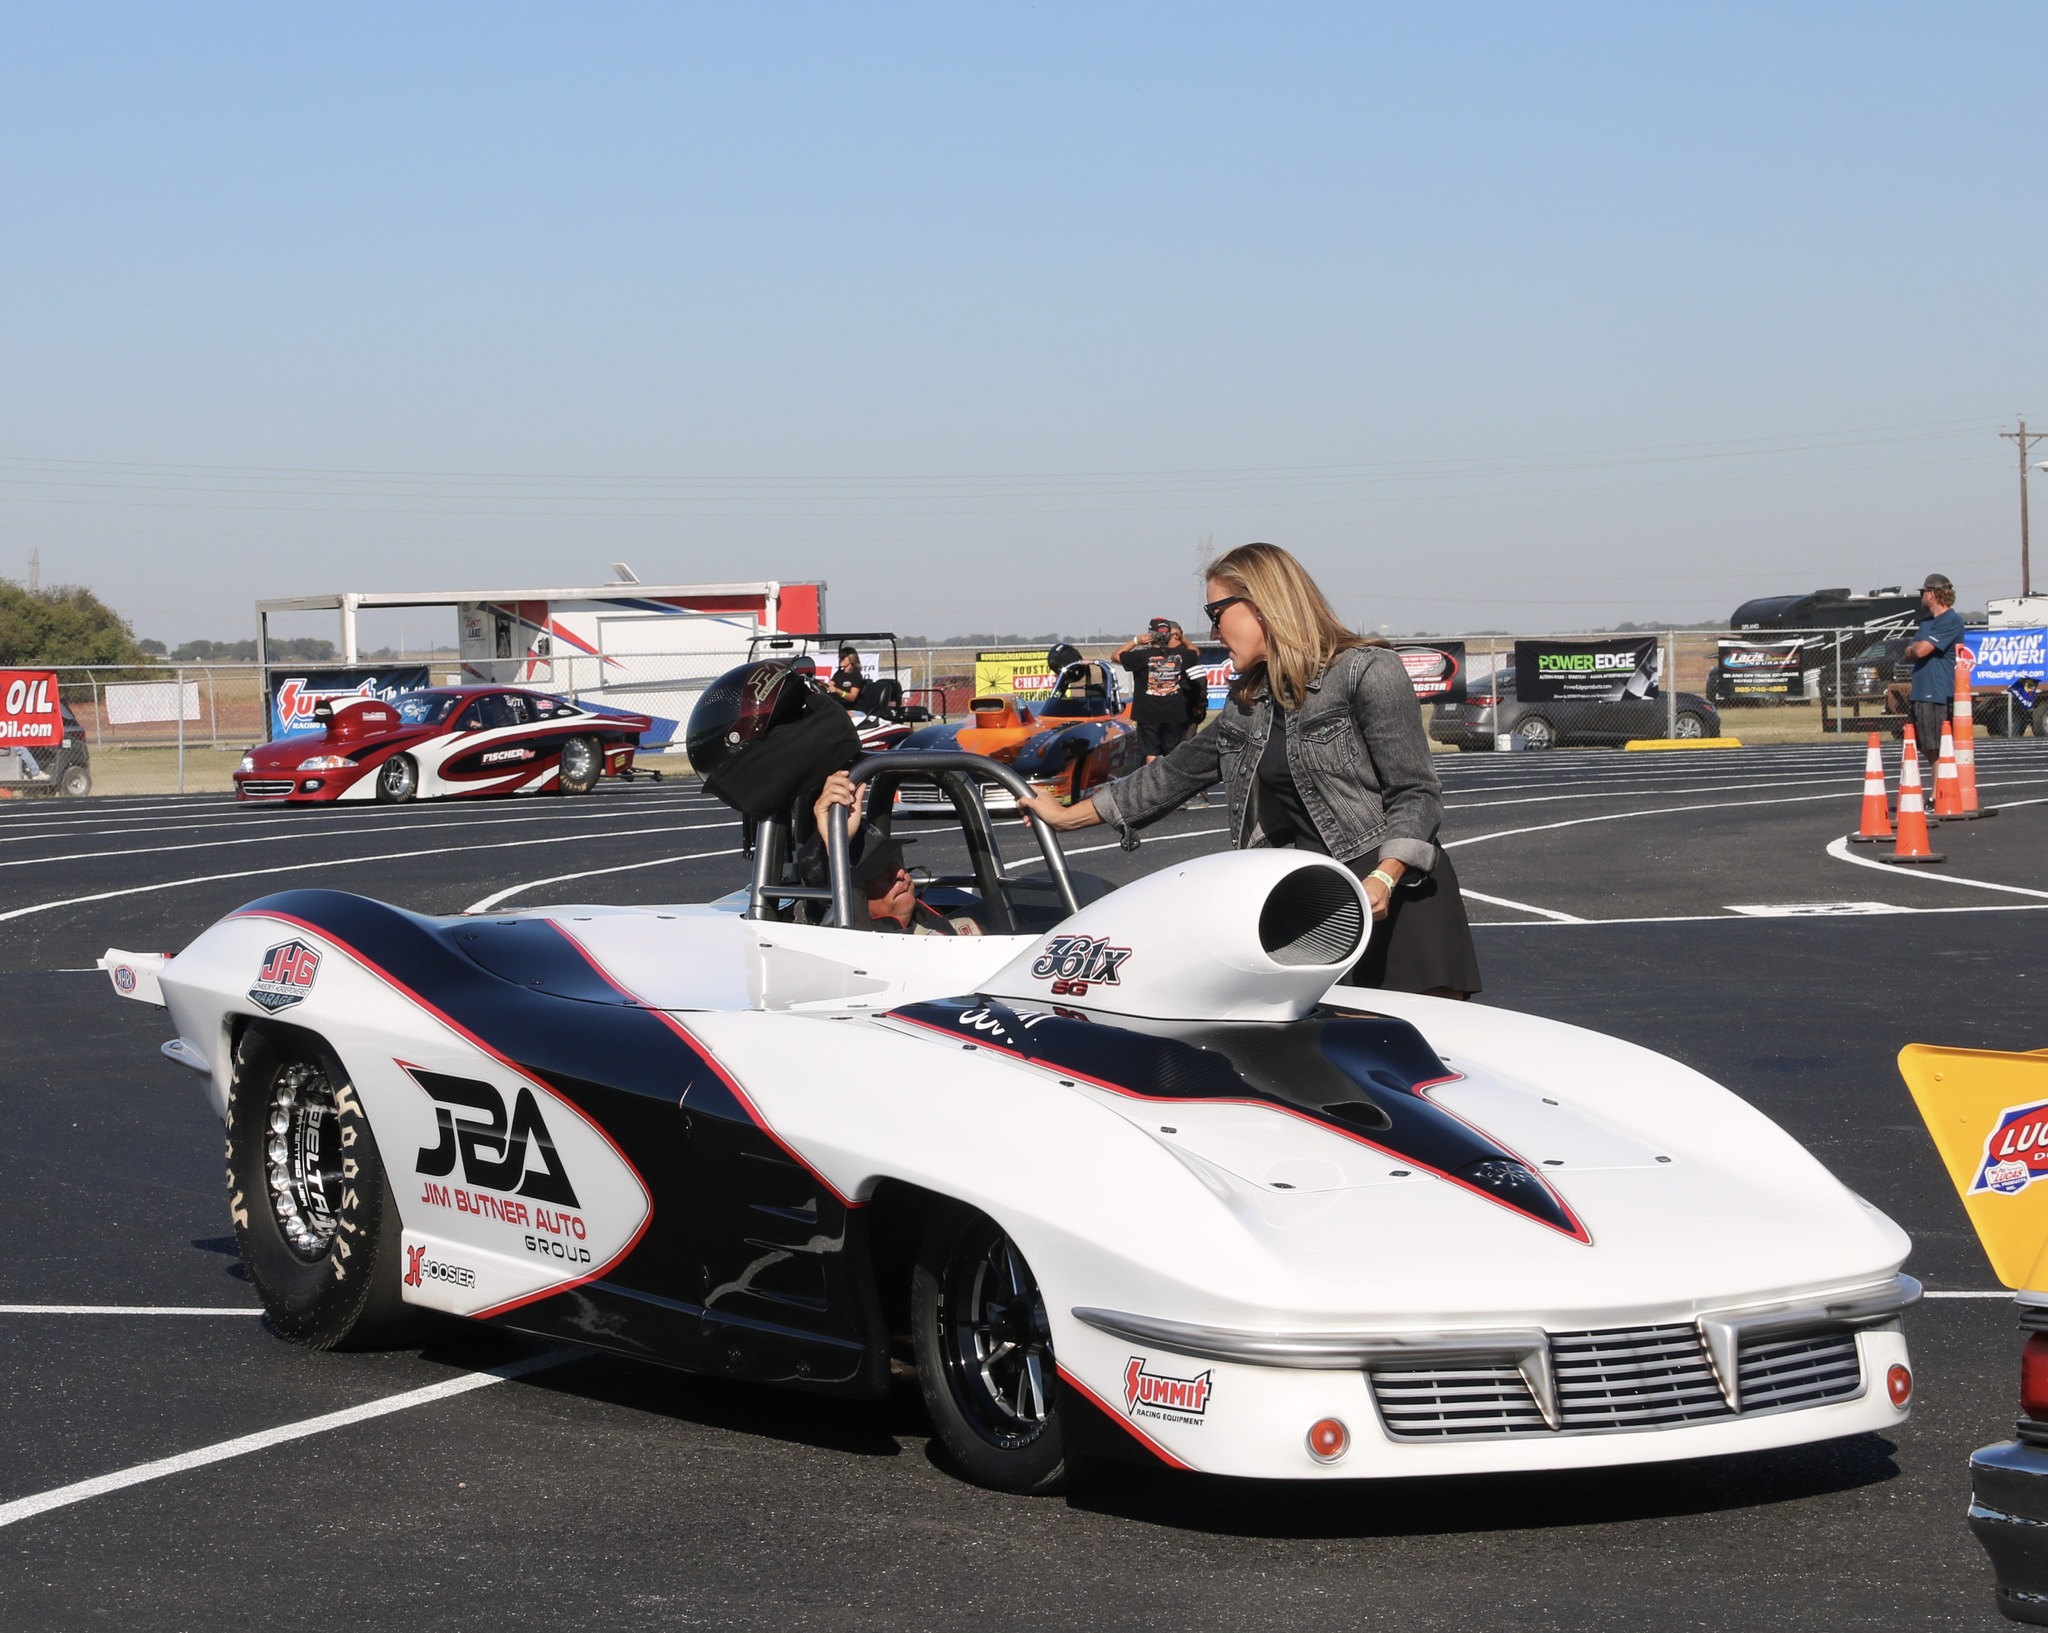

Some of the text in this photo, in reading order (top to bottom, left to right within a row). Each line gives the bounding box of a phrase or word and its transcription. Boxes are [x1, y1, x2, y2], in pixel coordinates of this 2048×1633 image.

[1979, 635, 2044, 651] MAKIN'
[1977, 649, 2046, 666] POWER!
[1013, 665, 1050, 675] HOUSTO
[1015, 675, 1057, 689] CHEAP
[6, 679, 53, 715] OIL
[482, 748, 524, 763] FISCHER
[260, 945, 319, 987] JHG
[117, 971, 134, 989] NHRA
[1051, 981, 1089, 997] SG
[254, 991, 294, 1006] GARAGE
[400, 1066, 582, 1210] JBA
[306, 1105, 331, 1215] DELTA
[1994, 1168, 2024, 1183] LUCAS
[2001, 1177, 2027, 1187] PRODUCTS
[421, 1182, 587, 1241] JIM BUTNER AUTO
[524, 1235, 591, 1264] GROUP
[421, 1259, 475, 1289] HOOSIER
[1136, 1408, 1204, 1427] RACING EQUIPMENT
